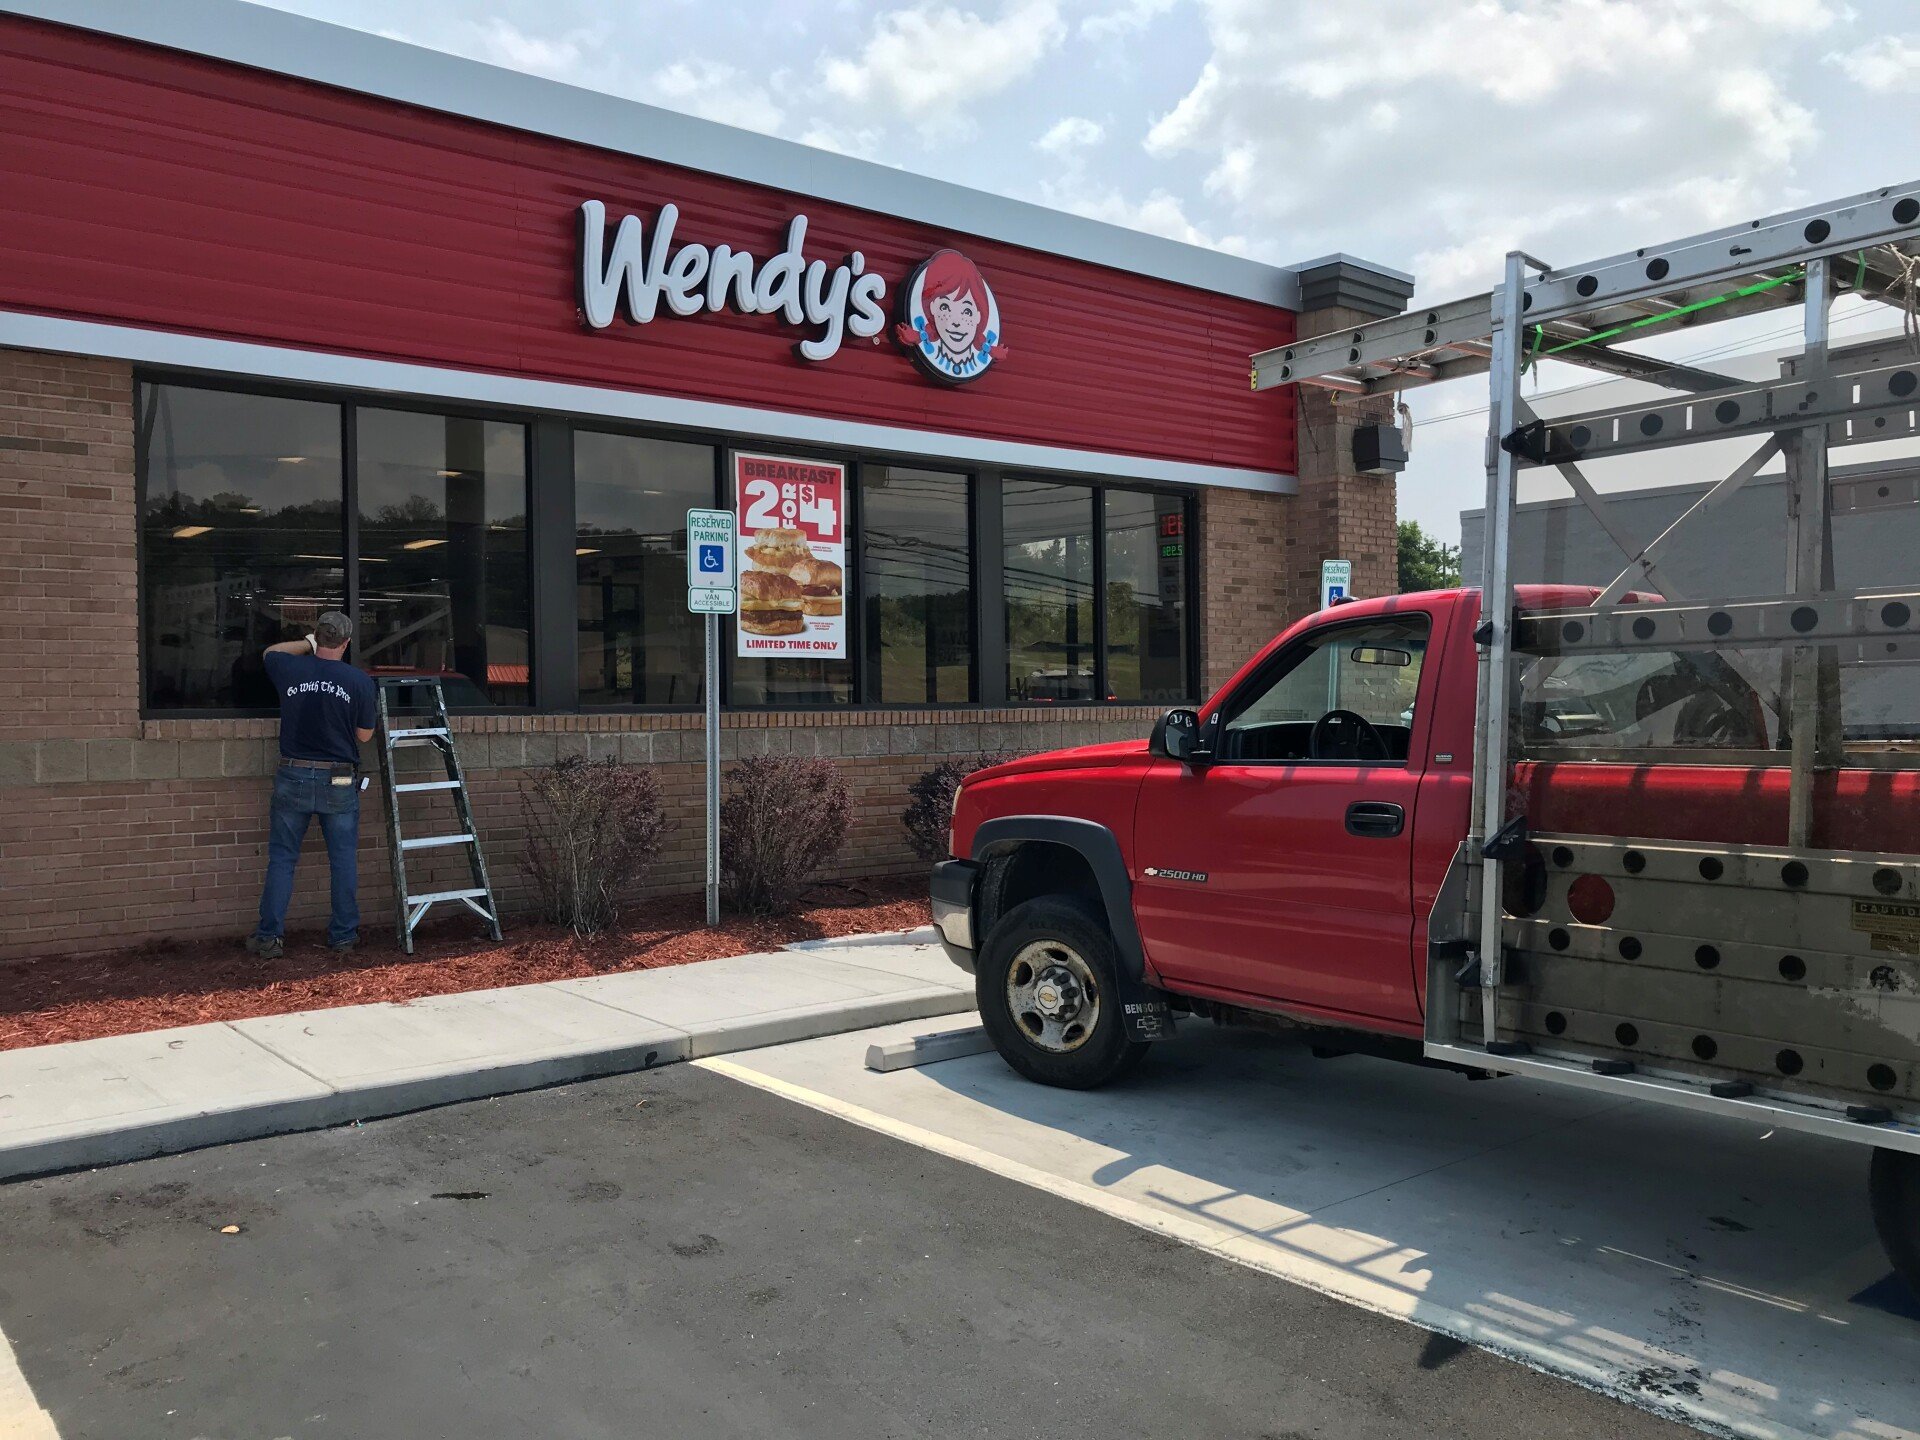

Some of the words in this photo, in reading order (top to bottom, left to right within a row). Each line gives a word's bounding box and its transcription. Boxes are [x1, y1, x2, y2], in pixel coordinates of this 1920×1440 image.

[580, 199, 886, 361] Wendy's
[744, 461, 836, 484] BREAKFAST
[745, 479, 780, 529] 2
[782, 482, 797, 530] FOR
[691, 516, 732, 530] RESERVED
[694, 531, 729, 543] PARKING
[1324, 565, 1349, 574] RESERVED
[1326, 575, 1347, 584] PARKING
[694, 600, 731, 608] ACCESSIBLE
[704, 593, 720, 601] VAN
[746, 639, 785, 651] LIMITED
[787, 640, 811, 651] TIME
[812, 641, 838, 651] ONLY
[286, 686, 299, 697] Go
[299, 680, 320, 694] With
[320, 681, 336, 695] The
[1158, 869, 1190, 881] 2500
[1191, 873, 1206, 883] HD
[1860, 903, 1920, 917] CAUTIO
